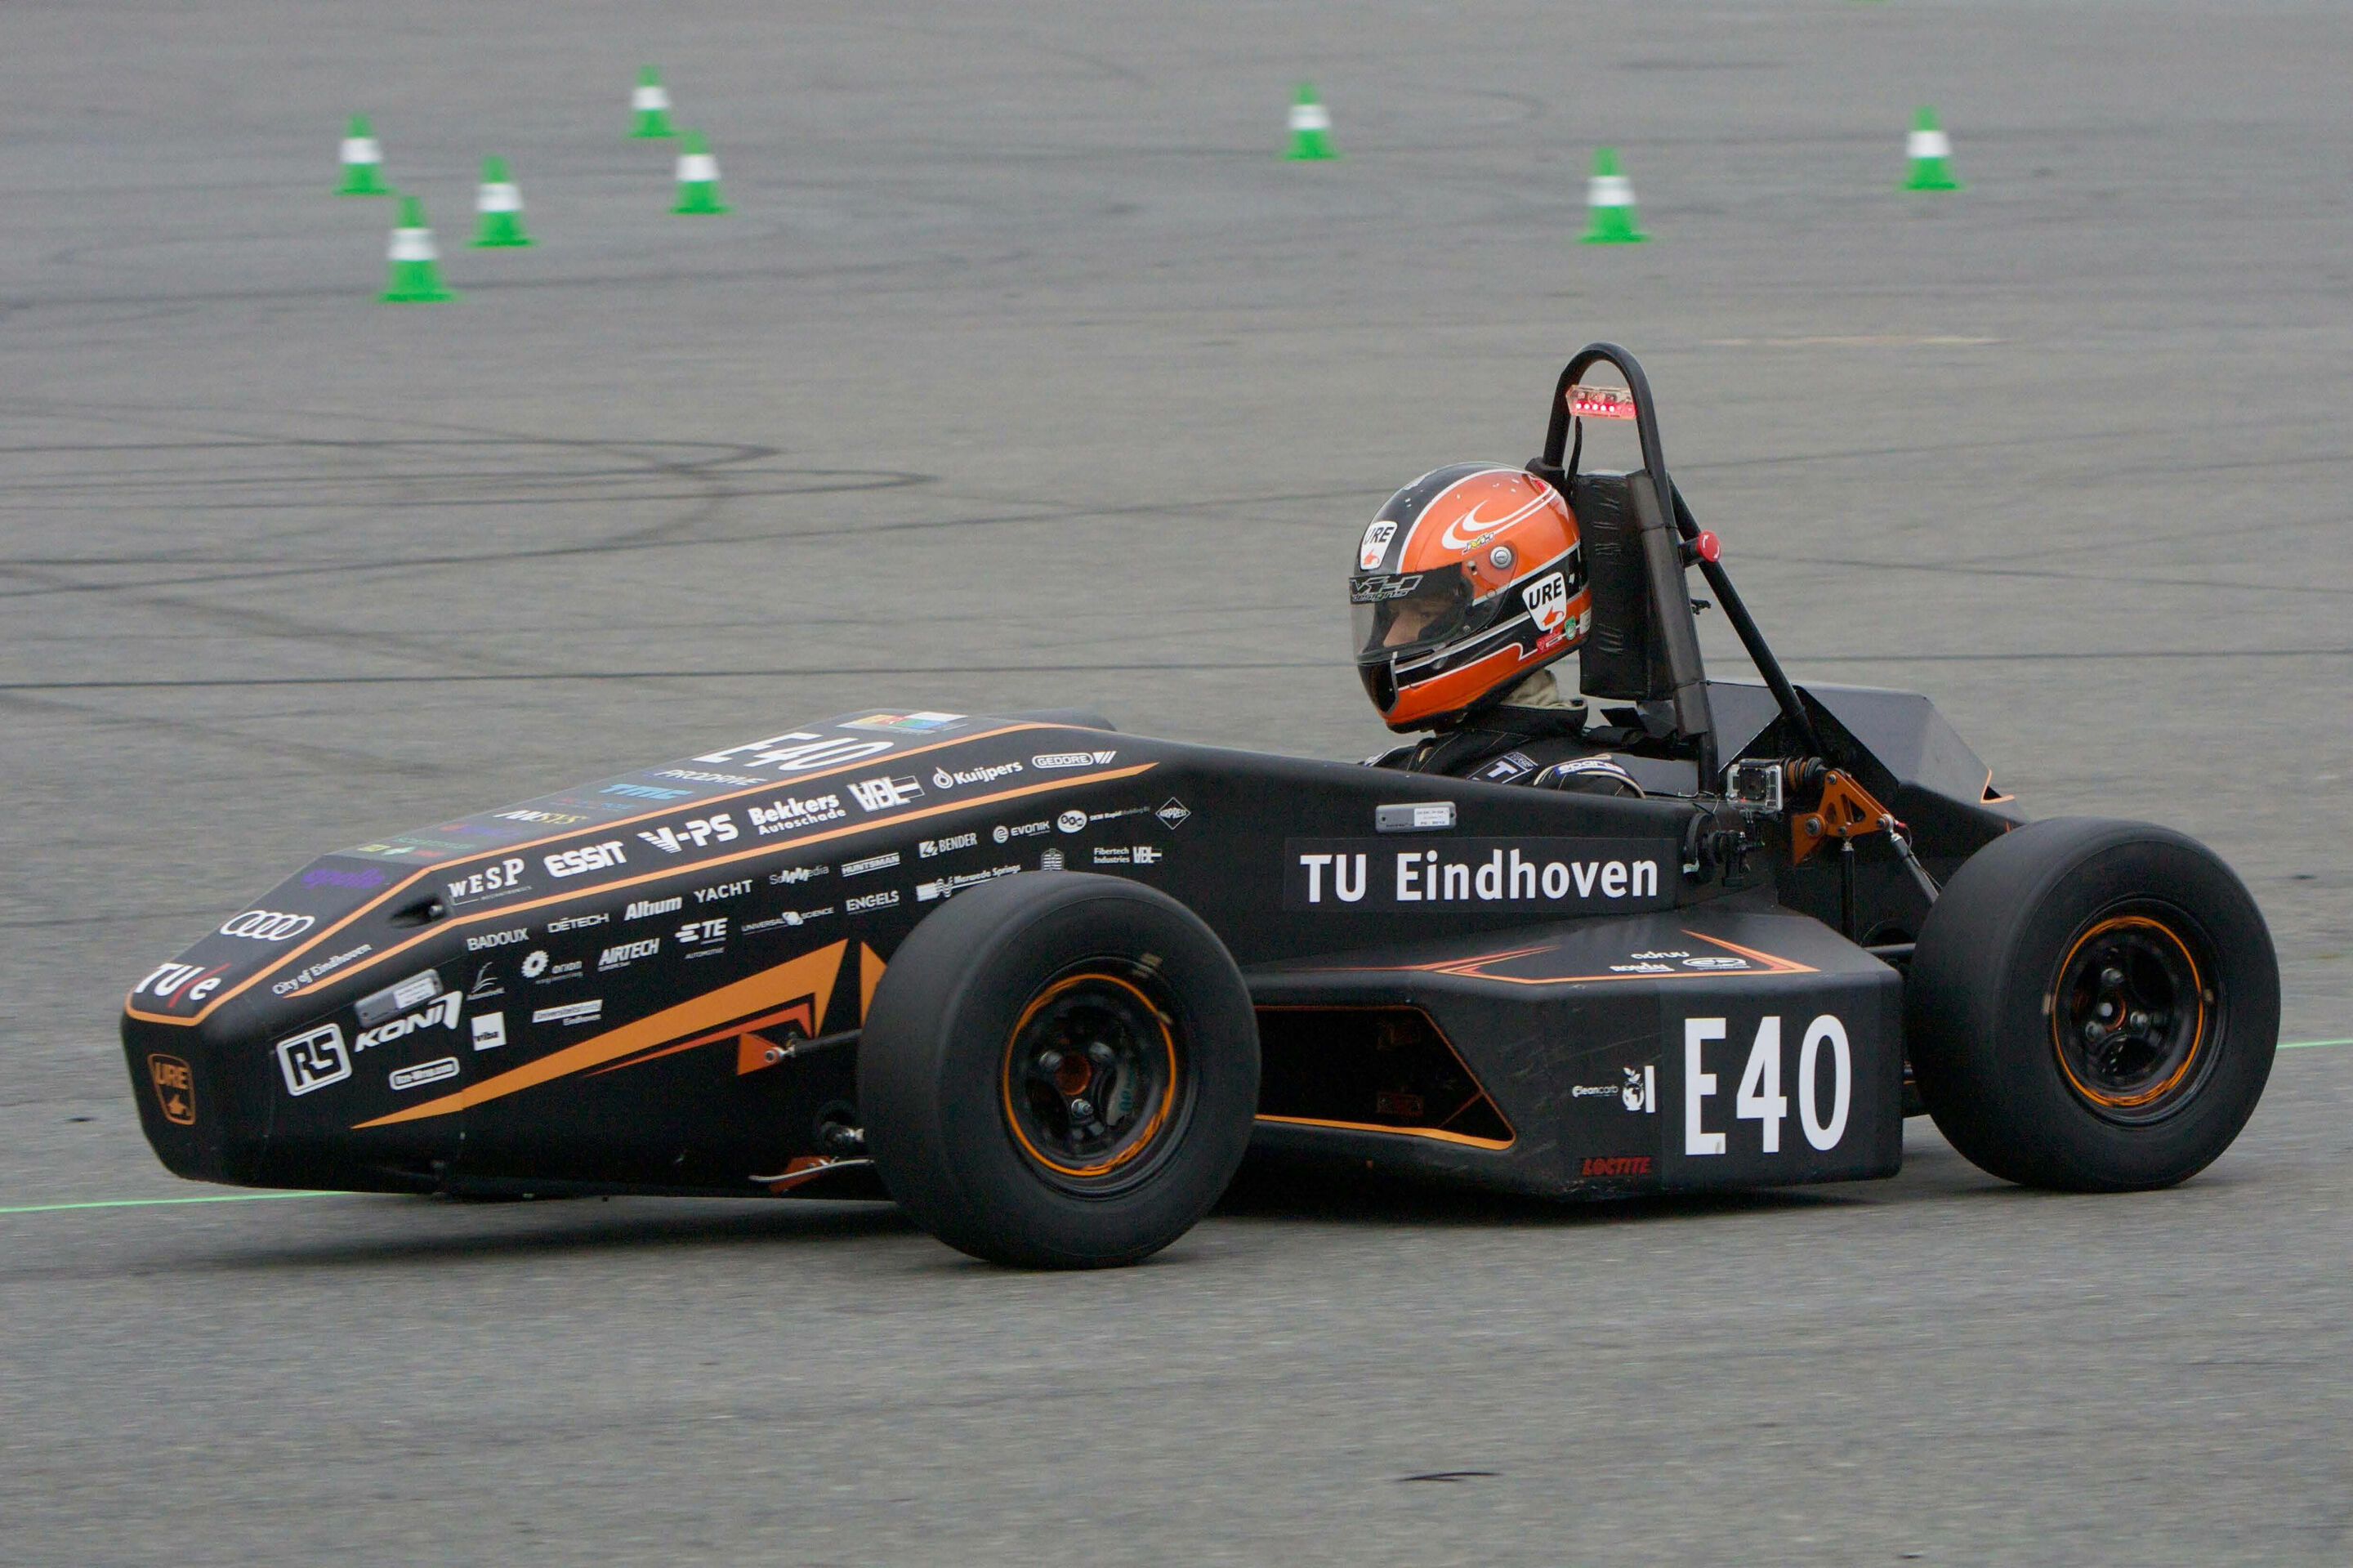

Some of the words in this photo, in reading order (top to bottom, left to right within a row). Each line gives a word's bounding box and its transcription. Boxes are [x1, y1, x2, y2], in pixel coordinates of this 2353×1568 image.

[1529, 577, 1562, 610] URE
[691, 732, 895, 771] E40
[1037, 755, 1090, 767] GEDORE
[953, 761, 1024, 786] Kuijpers
[748, 793, 841, 826] Bekkers
[758, 808, 847, 836] Autoschade
[939, 833, 978, 853] BENDER
[1093, 847, 1130, 855] Fibertech
[1132, 847, 1154, 864] VDL
[543, 840, 627, 878] ESSIT
[842, 856, 900, 874] HUNTSMAN
[447, 857, 525, 898] WESP
[1300, 853, 1367, 903] TU
[1396, 848, 1658, 901] Eindhoven
[694, 879, 753, 904] YACHT
[846, 890, 900, 913] ENGELS
[466, 927, 529, 952] BADOUX
[598, 938, 660, 967] AIRTECH
[286, 1031, 342, 1088] RS
[1684, 1014, 1852, 1156] E40
[1582, 1155, 1651, 1177] LOCTITE
